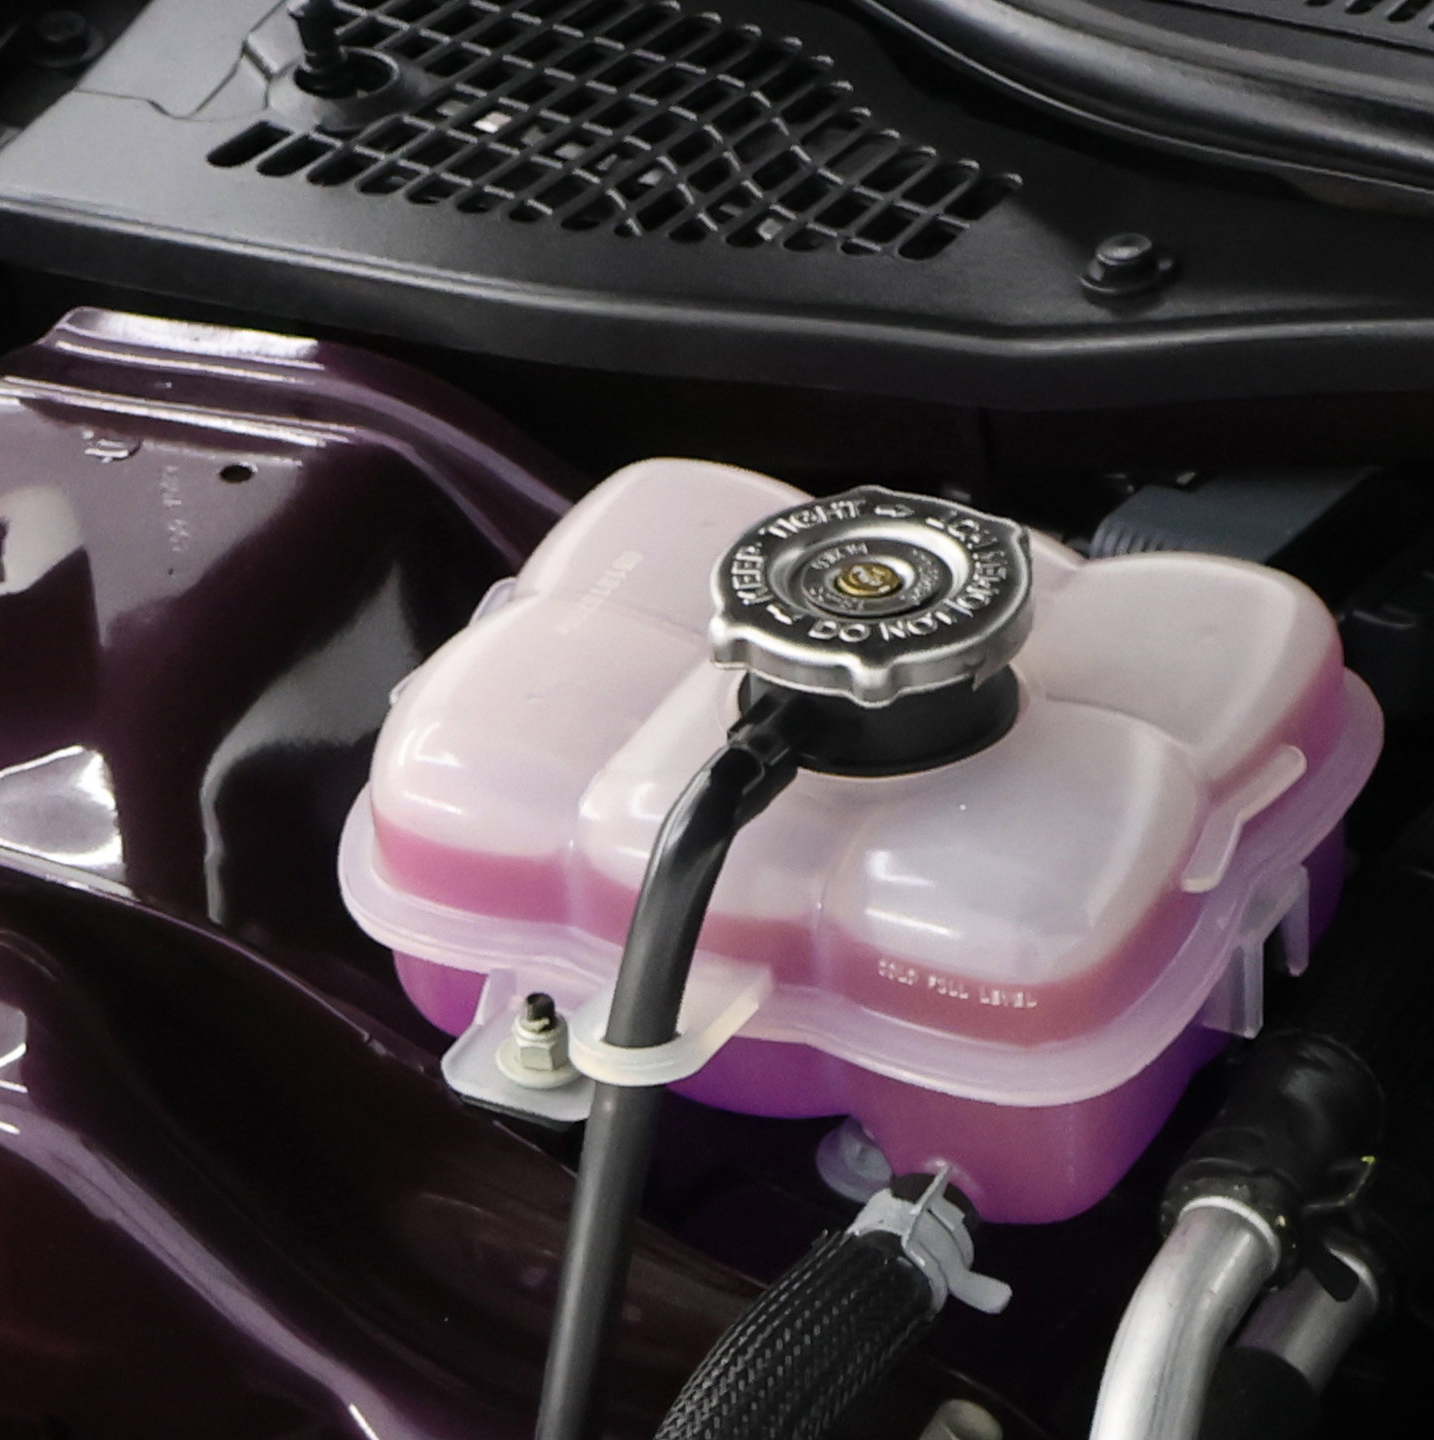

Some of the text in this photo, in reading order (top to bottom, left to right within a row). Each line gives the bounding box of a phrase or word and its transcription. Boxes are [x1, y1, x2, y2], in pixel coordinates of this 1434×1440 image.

[731, 541, 773, 606] KEEP
[760, 498, 867, 539] TIGHT
[807, 620, 871, 644] DO
[878, 610, 953, 641] NOT
[927, 975, 970, 1000] FILL
[979, 986, 1038, 1009] LEVEL
